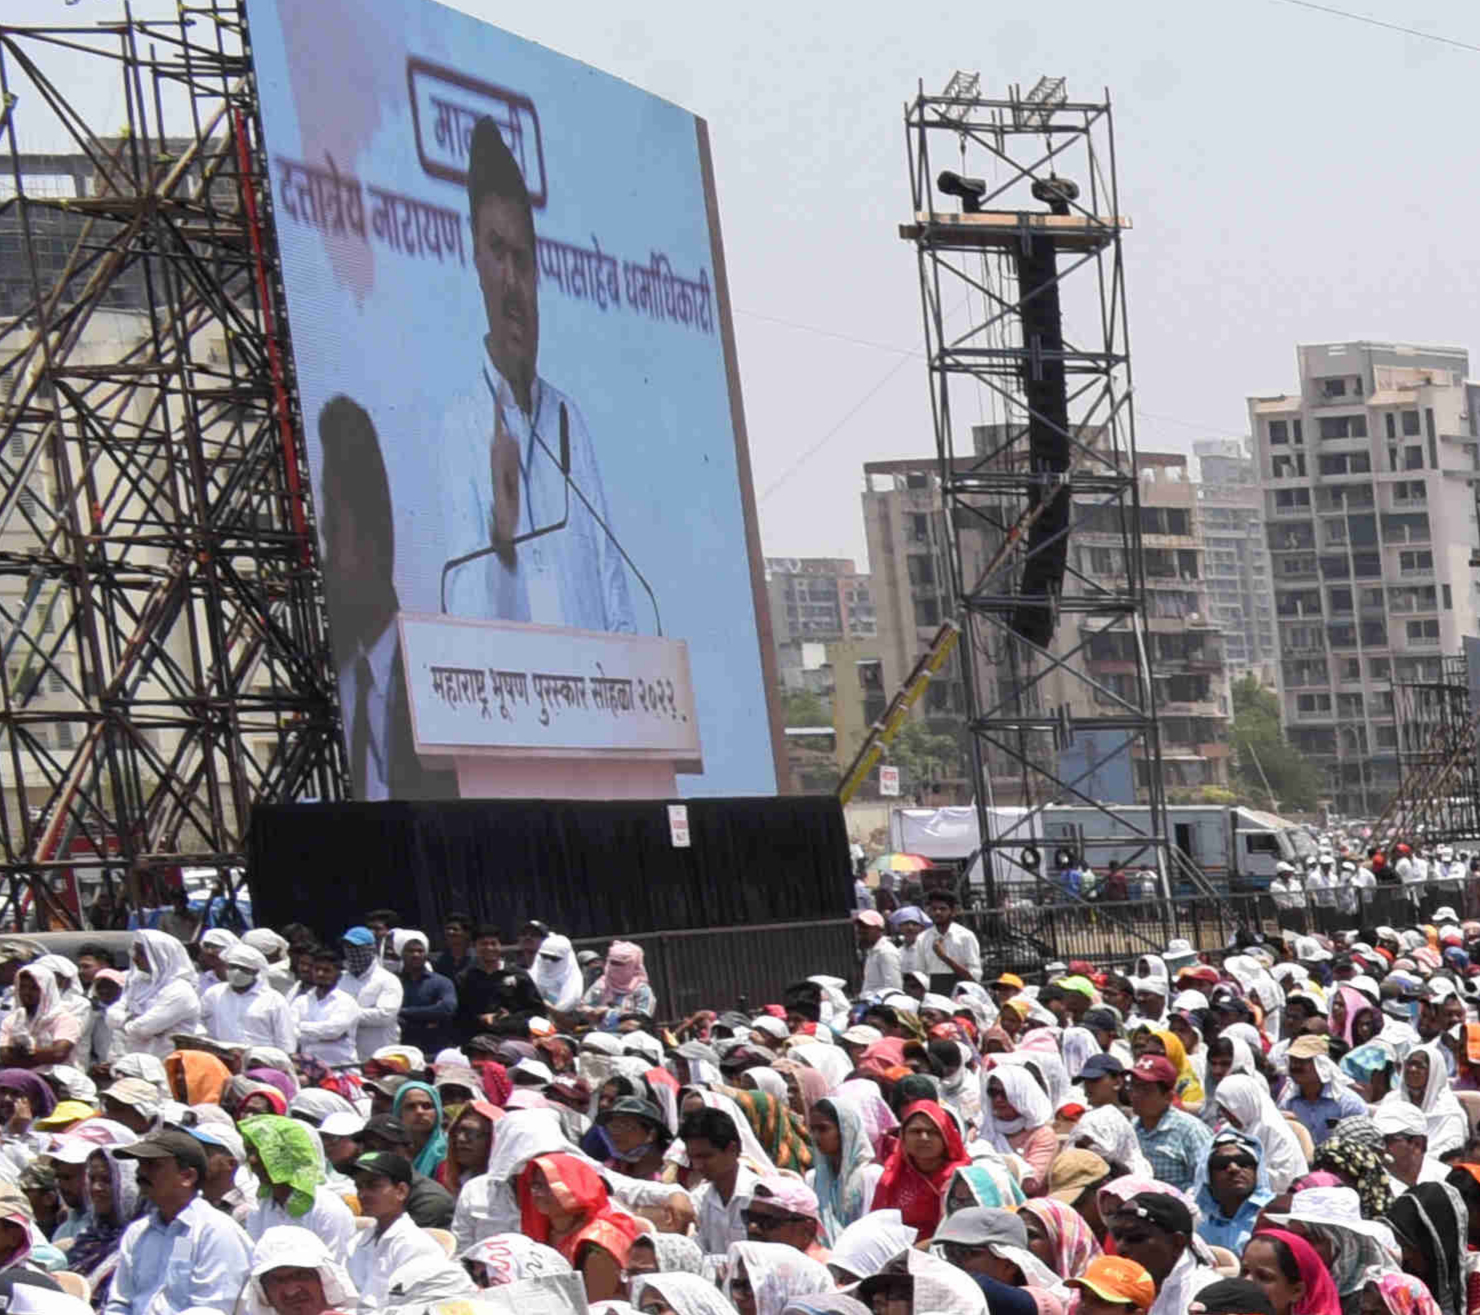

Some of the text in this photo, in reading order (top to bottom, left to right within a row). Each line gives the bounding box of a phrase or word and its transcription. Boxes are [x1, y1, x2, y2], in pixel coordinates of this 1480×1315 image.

[275, 150, 367, 244] दत्तात्रेय
[367, 184, 467, 268] नारायण
[623, 248, 714, 335] धर्माधिकारी
[430, 666, 491, 719] महाराष्ट्र
[488, 668, 529, 723] भूषण
[533, 672, 588, 726] पुरस्कार
[589, 662, 635, 718] सोहळा
